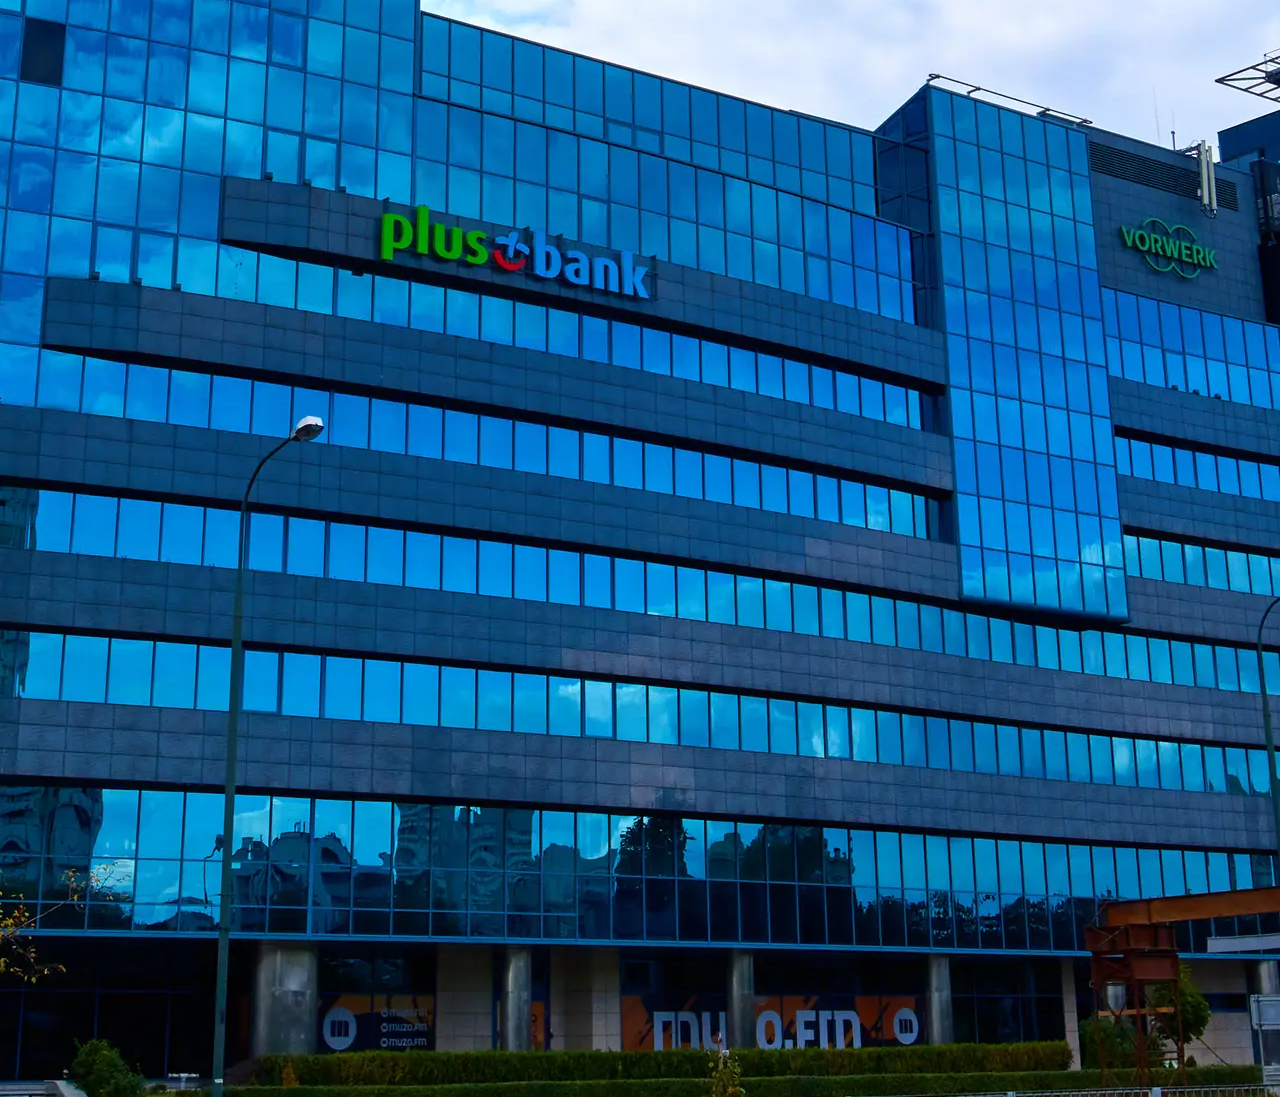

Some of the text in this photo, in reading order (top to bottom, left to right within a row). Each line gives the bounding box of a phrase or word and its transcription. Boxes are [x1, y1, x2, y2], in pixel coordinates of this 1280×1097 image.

[380, 204, 650, 299] plus bank
[1120, 225, 1218, 270] VORWERK
